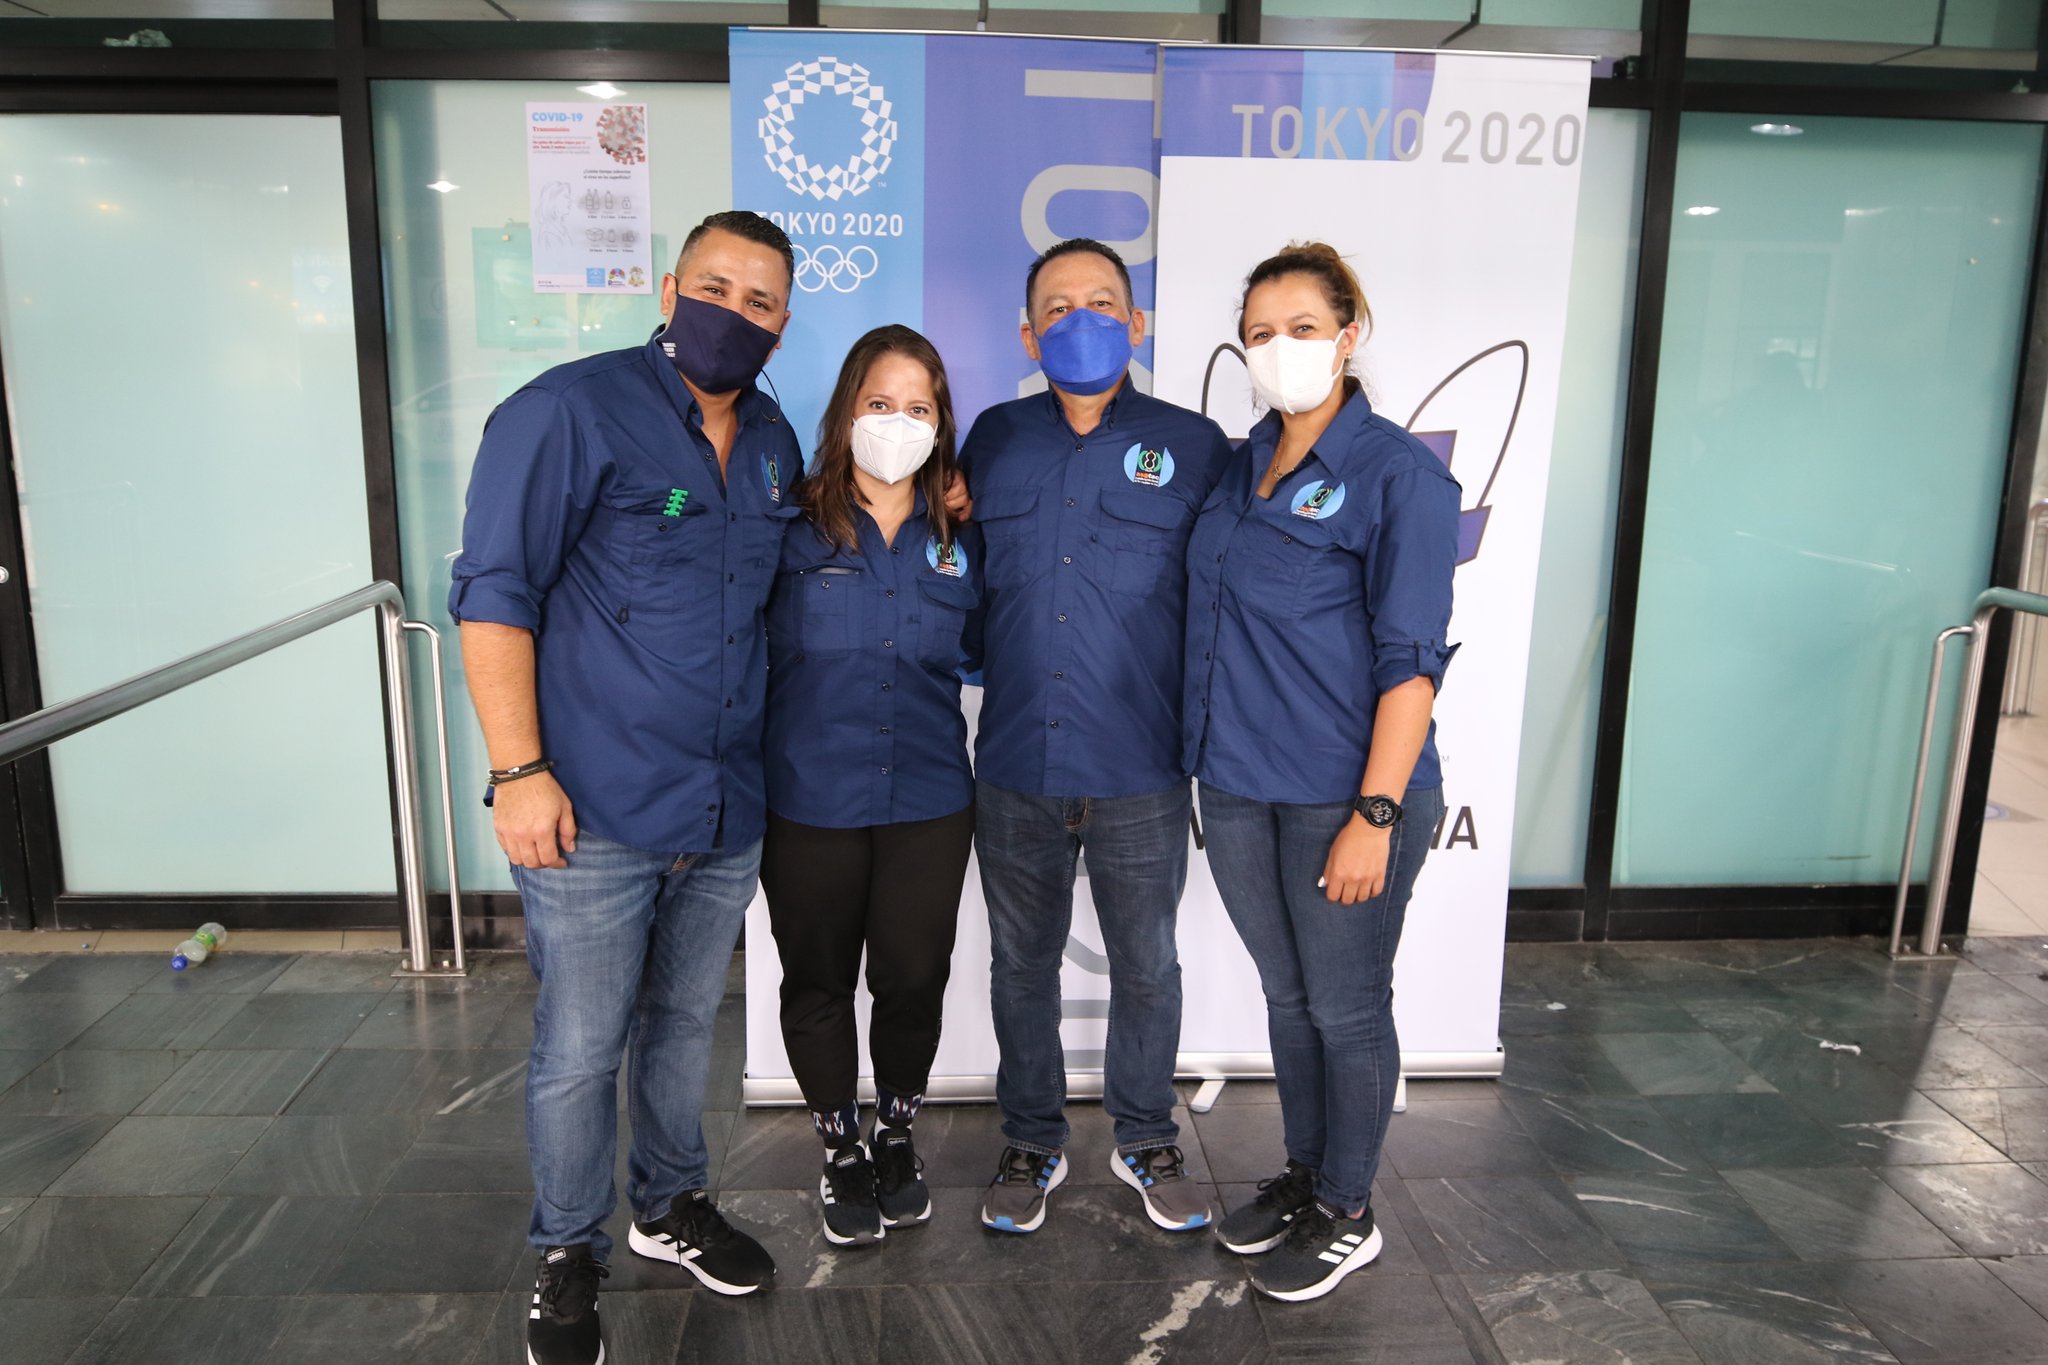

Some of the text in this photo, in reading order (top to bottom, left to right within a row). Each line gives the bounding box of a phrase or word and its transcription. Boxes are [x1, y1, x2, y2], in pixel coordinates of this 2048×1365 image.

[531, 112, 583, 122] COVID-19
[1232, 104, 1581, 166] TOKYO 2020
[755, 211, 903, 237] OKYO 2020
